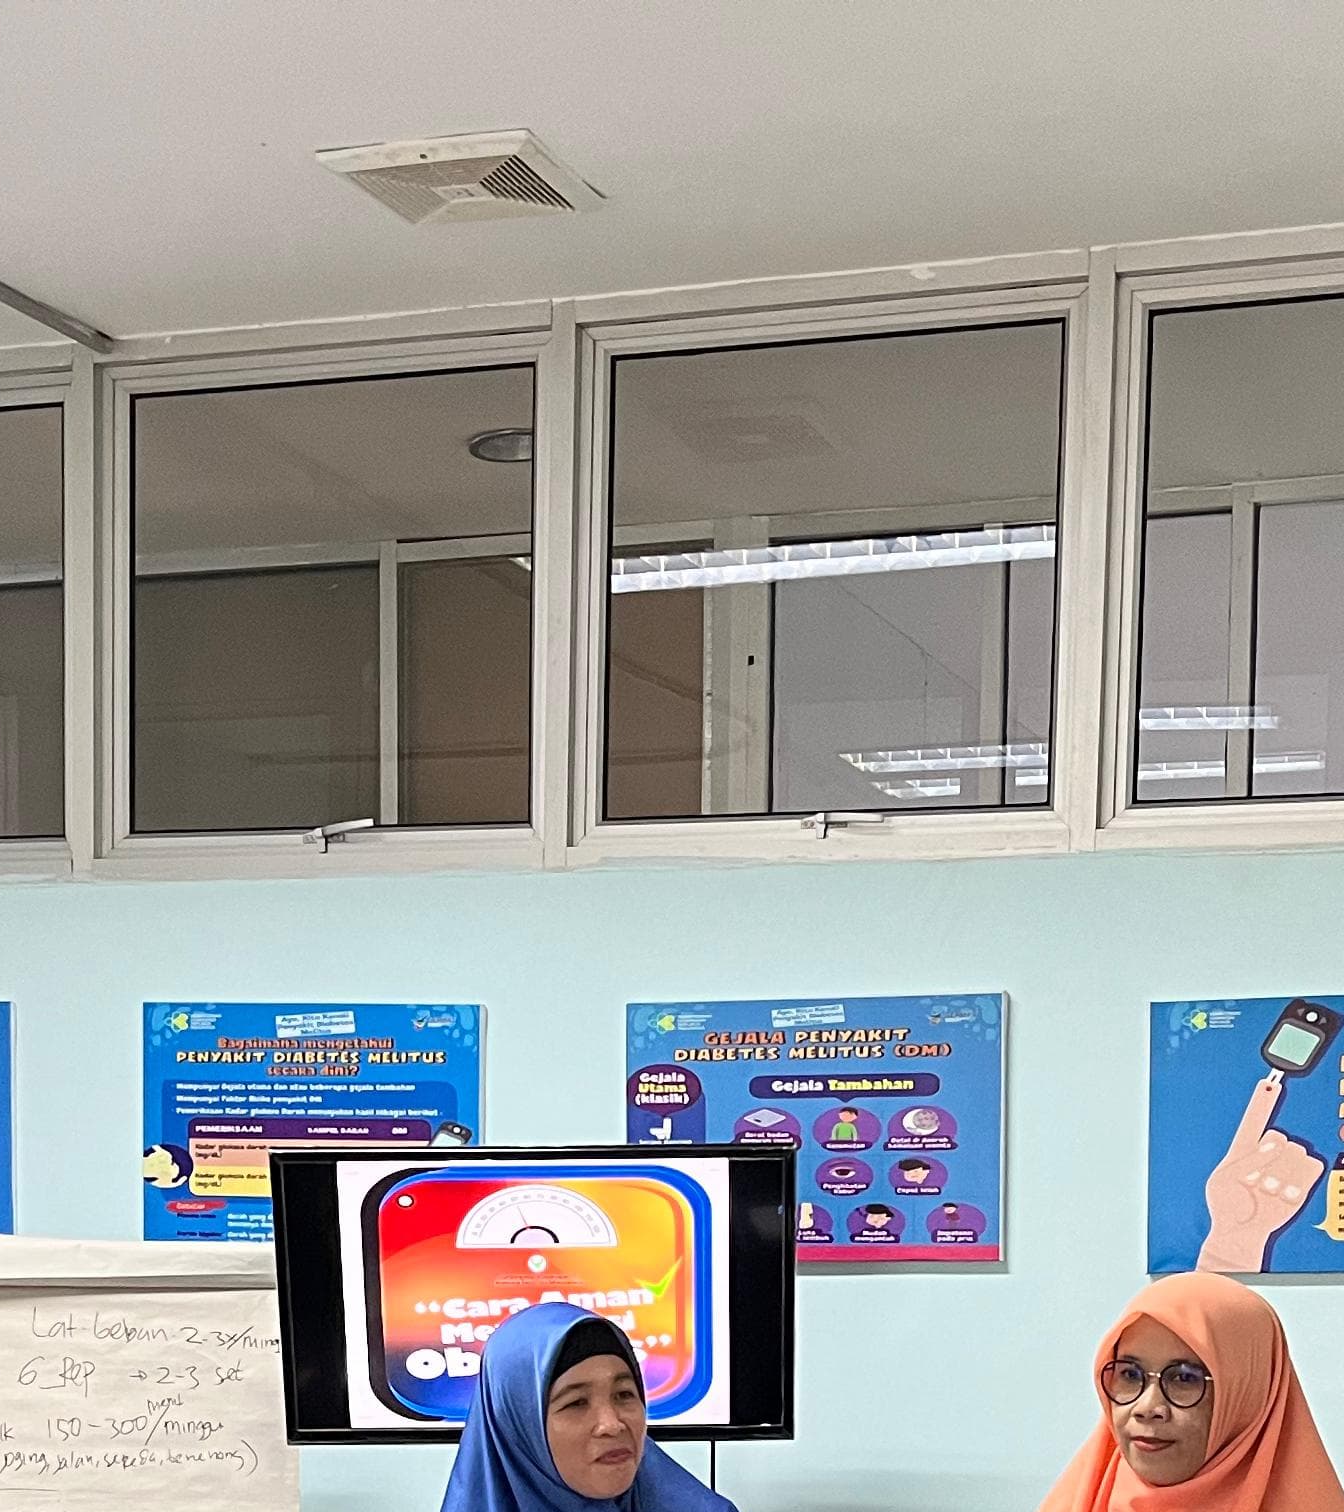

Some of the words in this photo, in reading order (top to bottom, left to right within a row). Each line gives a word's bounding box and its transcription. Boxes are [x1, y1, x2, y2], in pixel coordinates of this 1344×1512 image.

[703, 1031, 786, 1045] GEJALA
[794, 1028, 910, 1044] PENYAKIT
[217, 1038, 300, 1050] Bagaimana
[303, 1038, 394, 1050] mengetahui
[176, 1051, 266, 1063] PENYAKIT
[273, 1051, 360, 1064] DIABETES
[367, 1051, 446, 1064] MELITUS
[674, 1047, 780, 1062] DIABETES
[788, 1045, 885, 1059] MELITUS
[893, 1043, 952, 1057] (DM)
[267, 1066, 317, 1077] secara
[319, 1064, 360, 1076] dini?
[639, 1072, 686, 1085] Gejala
[638, 1082, 687, 1093] Utama
[771, 1080, 824, 1093] Gejala
[827, 1079, 914, 1091] Tambahan
[634, 1093, 690, 1106] (klasik)
[539, 1288, 656, 1310] Aman
